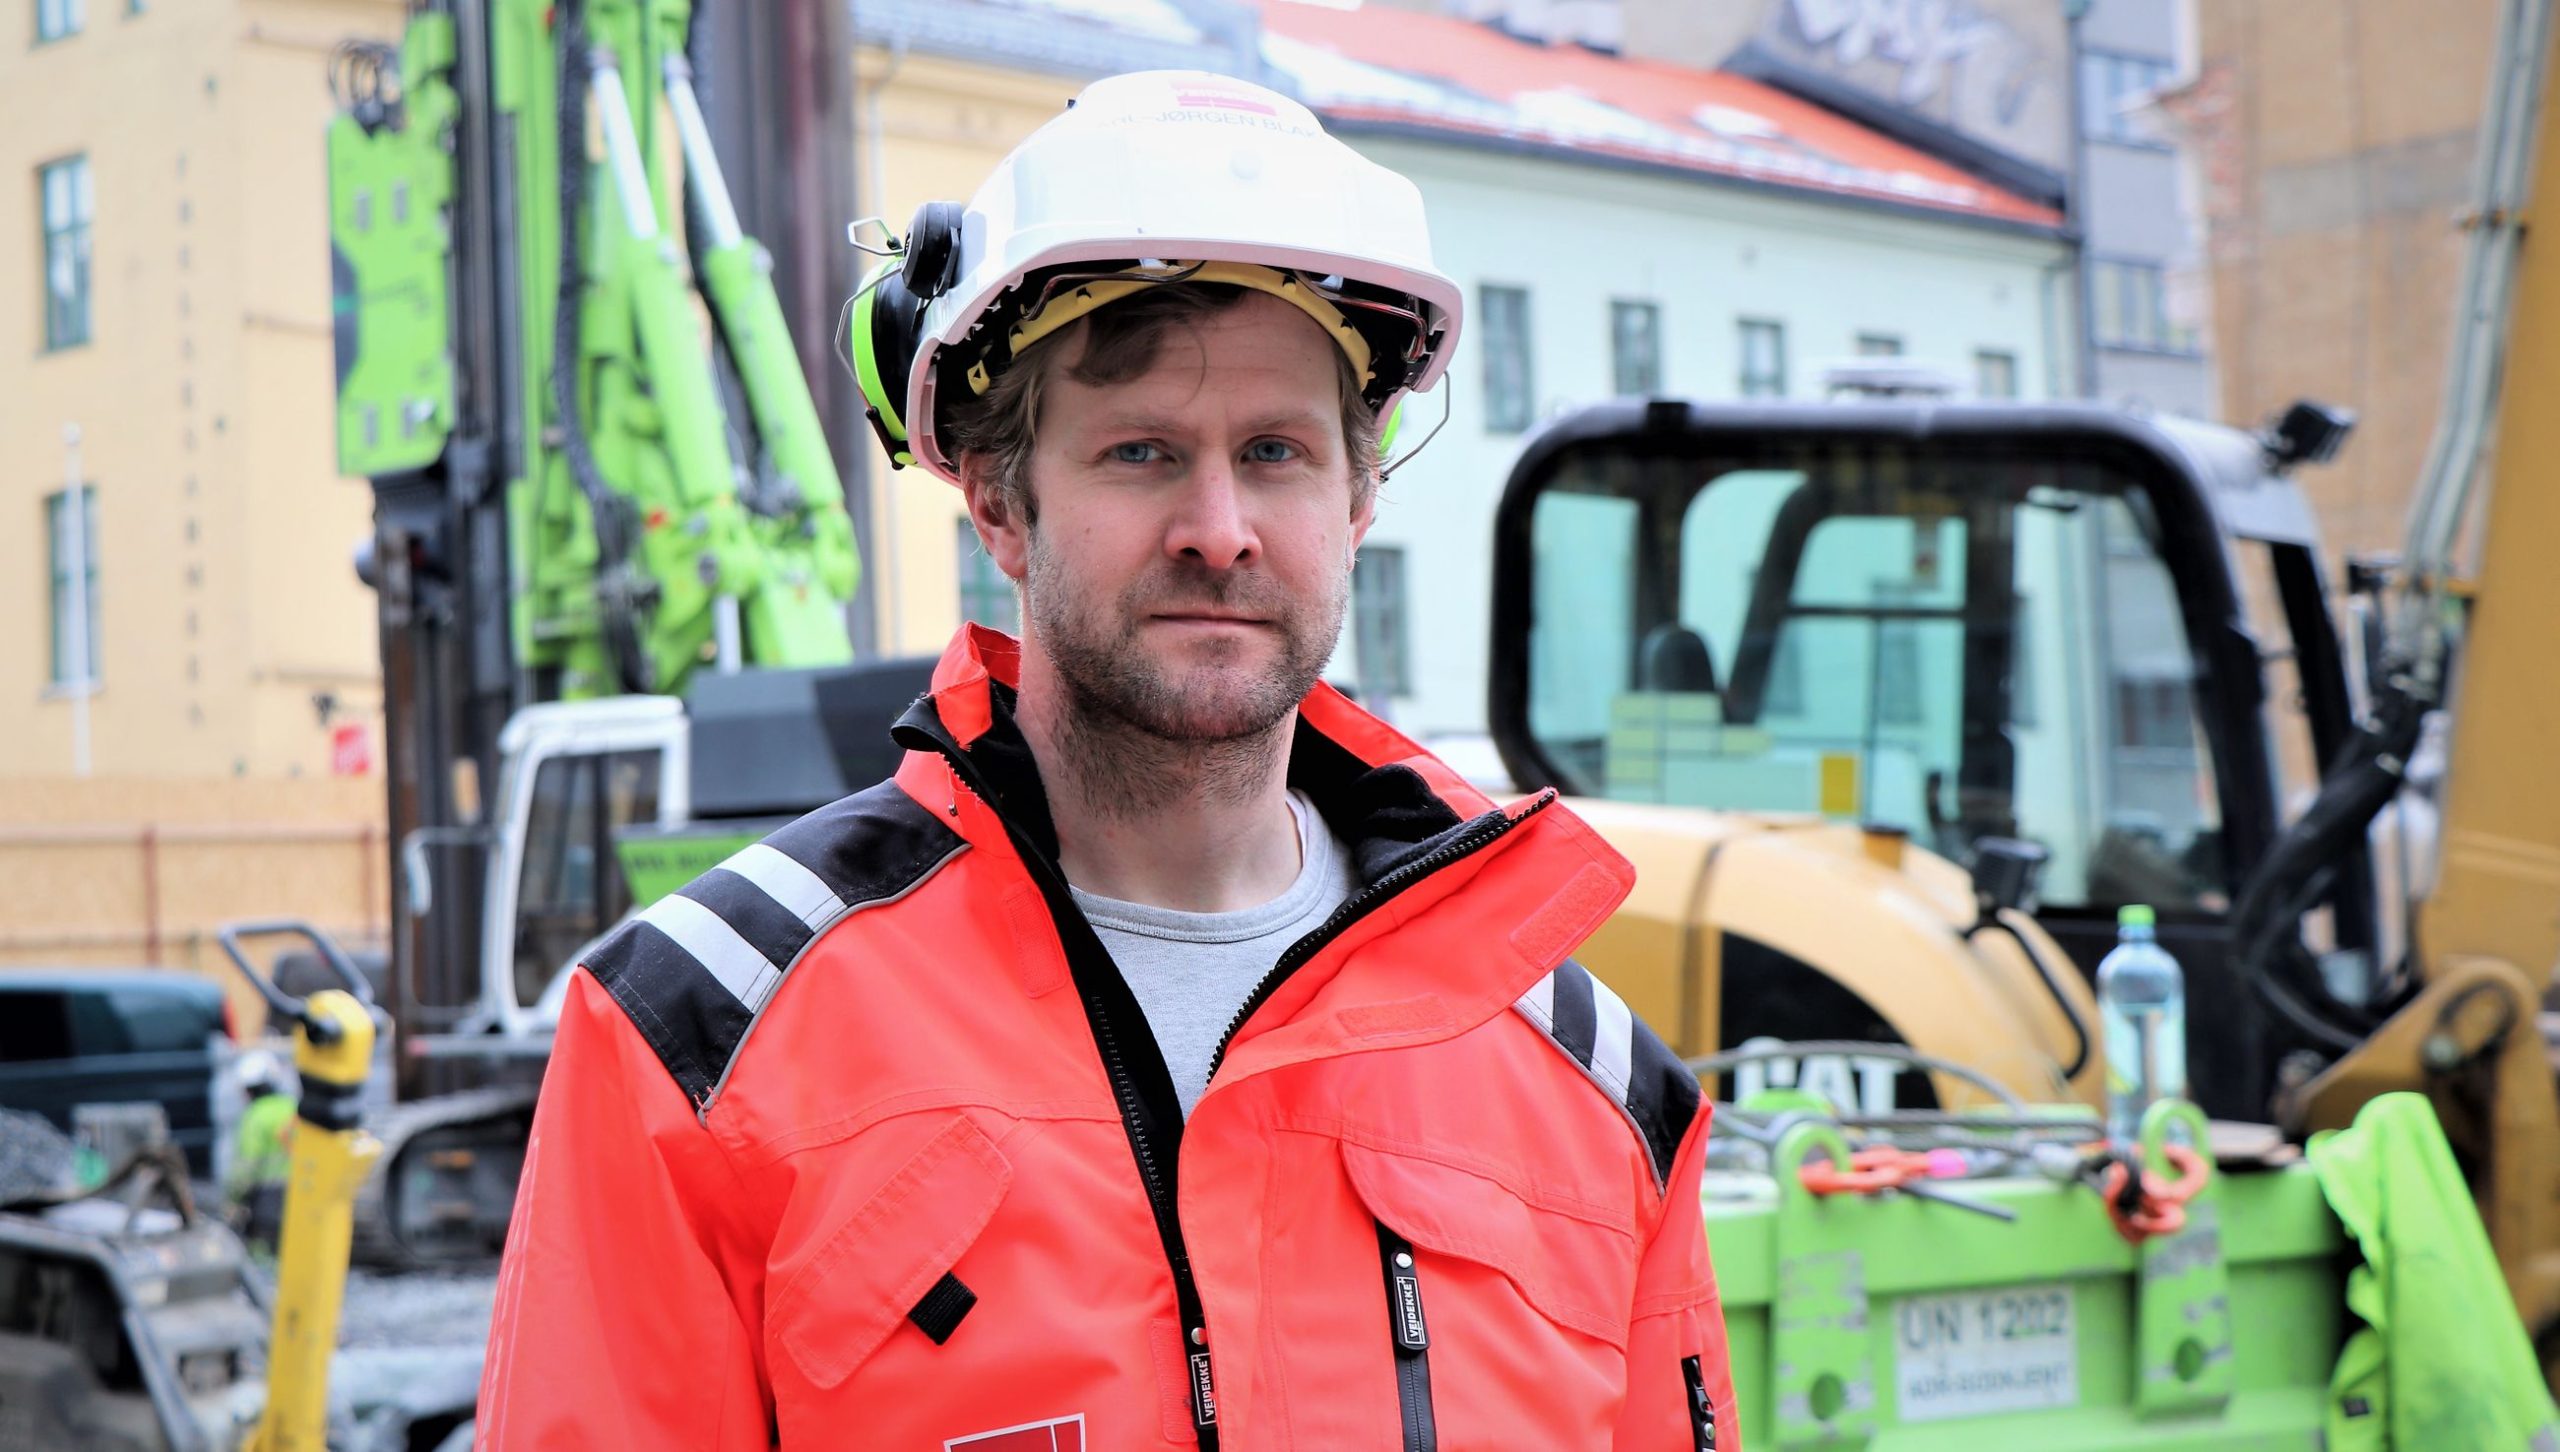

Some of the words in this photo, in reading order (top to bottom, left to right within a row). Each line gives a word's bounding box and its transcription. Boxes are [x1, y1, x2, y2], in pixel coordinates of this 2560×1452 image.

[1734, 1036, 1908, 1115] CAT
[1403, 1283, 1419, 1338] VEIDEKKE
[1901, 1302, 1962, 1349] UN
[1199, 1360, 1215, 1417] VEIDEKKE
